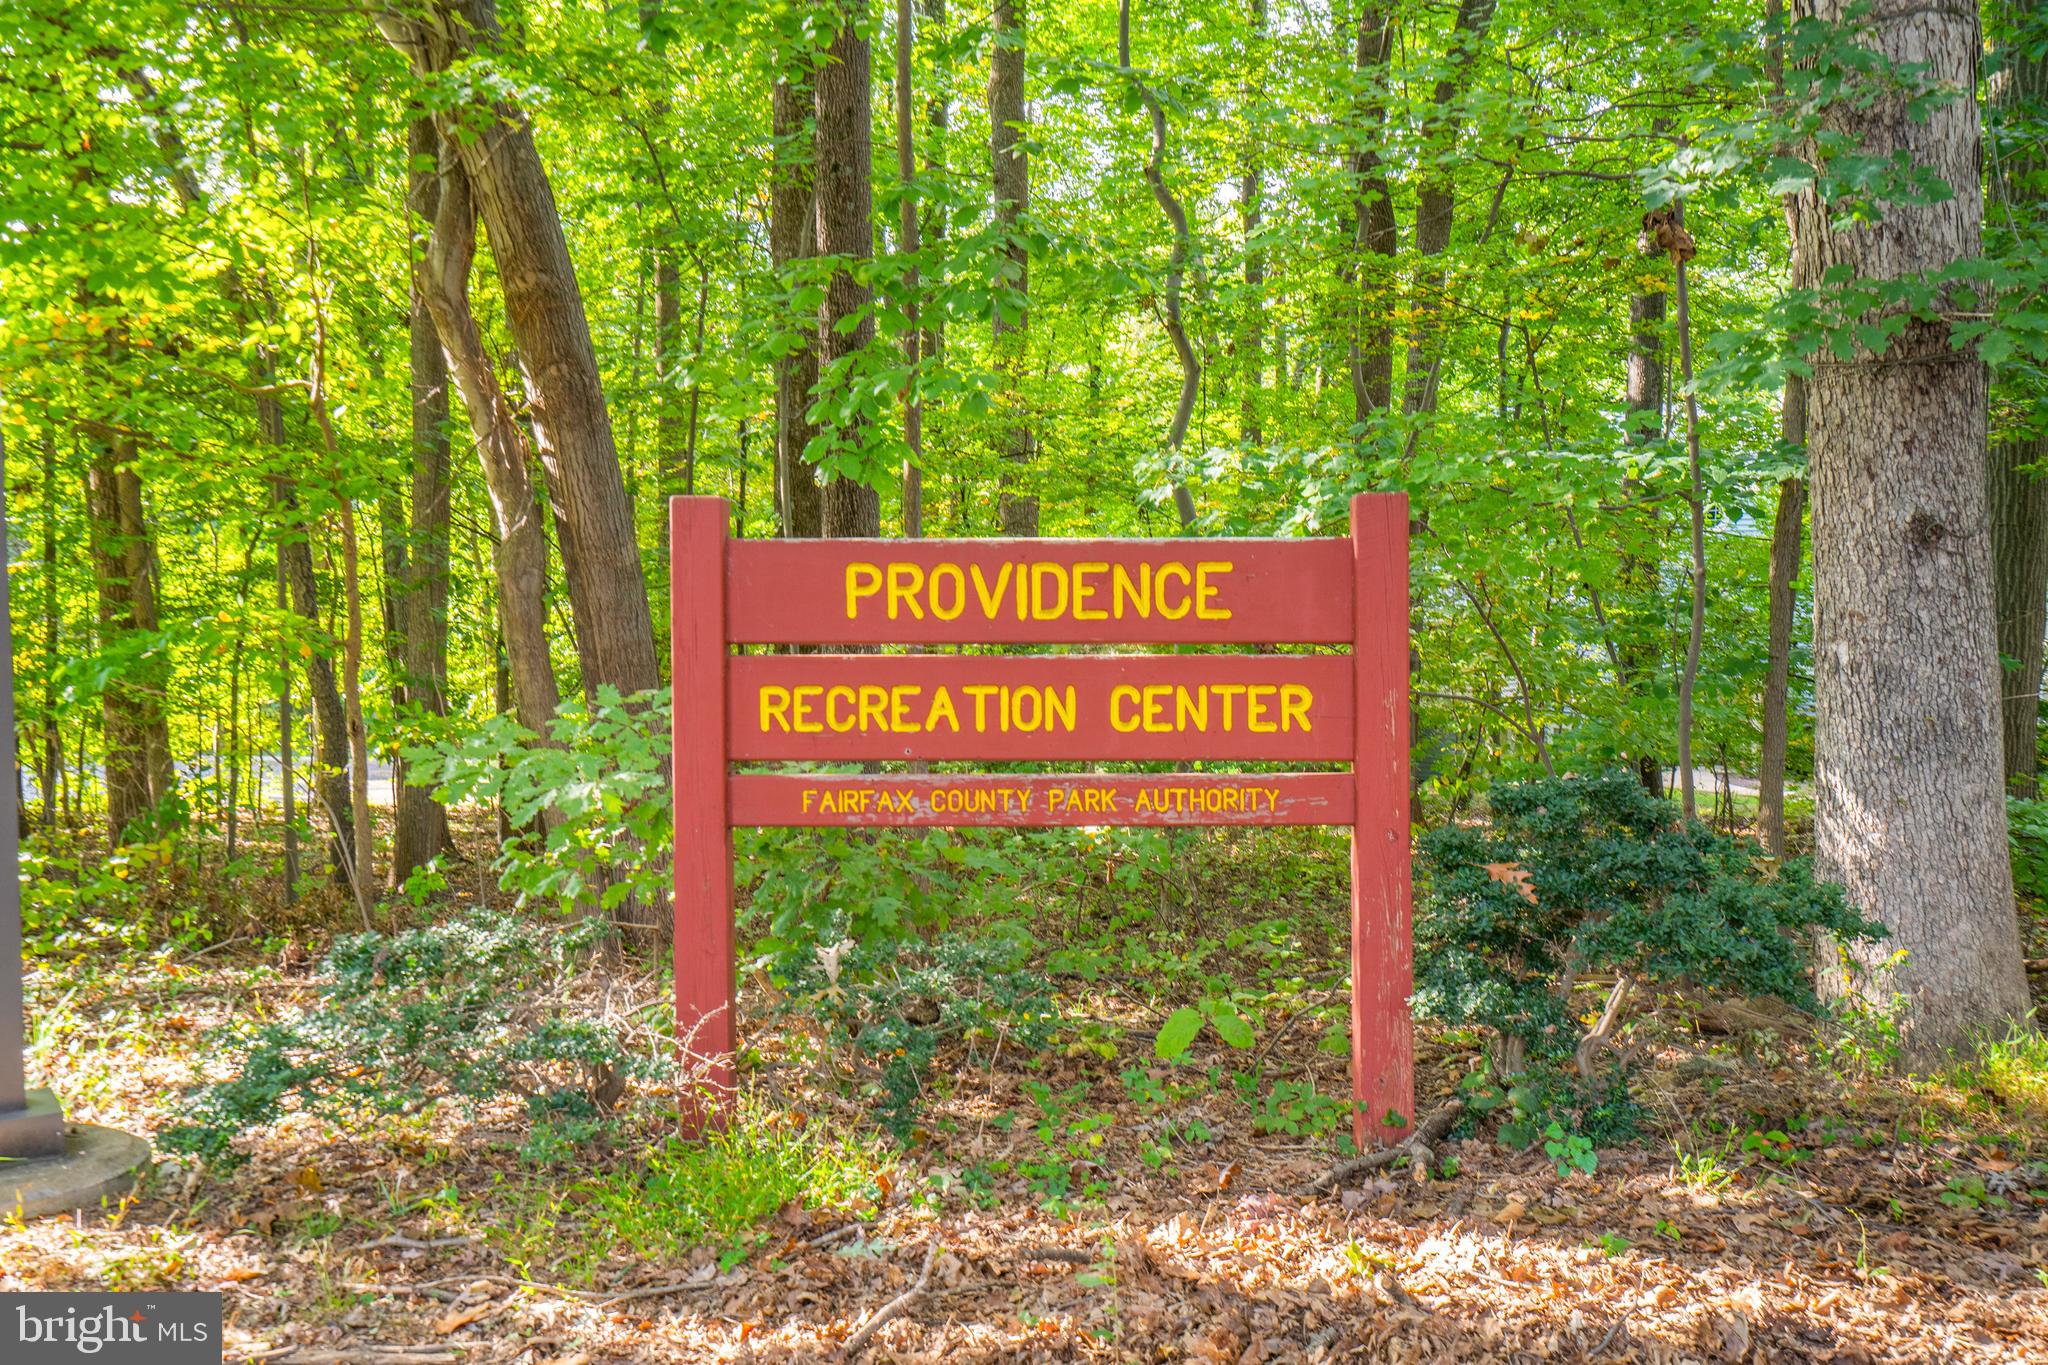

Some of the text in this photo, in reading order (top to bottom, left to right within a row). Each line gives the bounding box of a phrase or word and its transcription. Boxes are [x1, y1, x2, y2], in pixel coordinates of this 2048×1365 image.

[845, 560, 1234, 622] PROVIDENCE
[758, 683, 1313, 733] RECREATION CENTER
[801, 786, 1281, 814] FAIRFAX COUNTY PARK AUTHORITY
